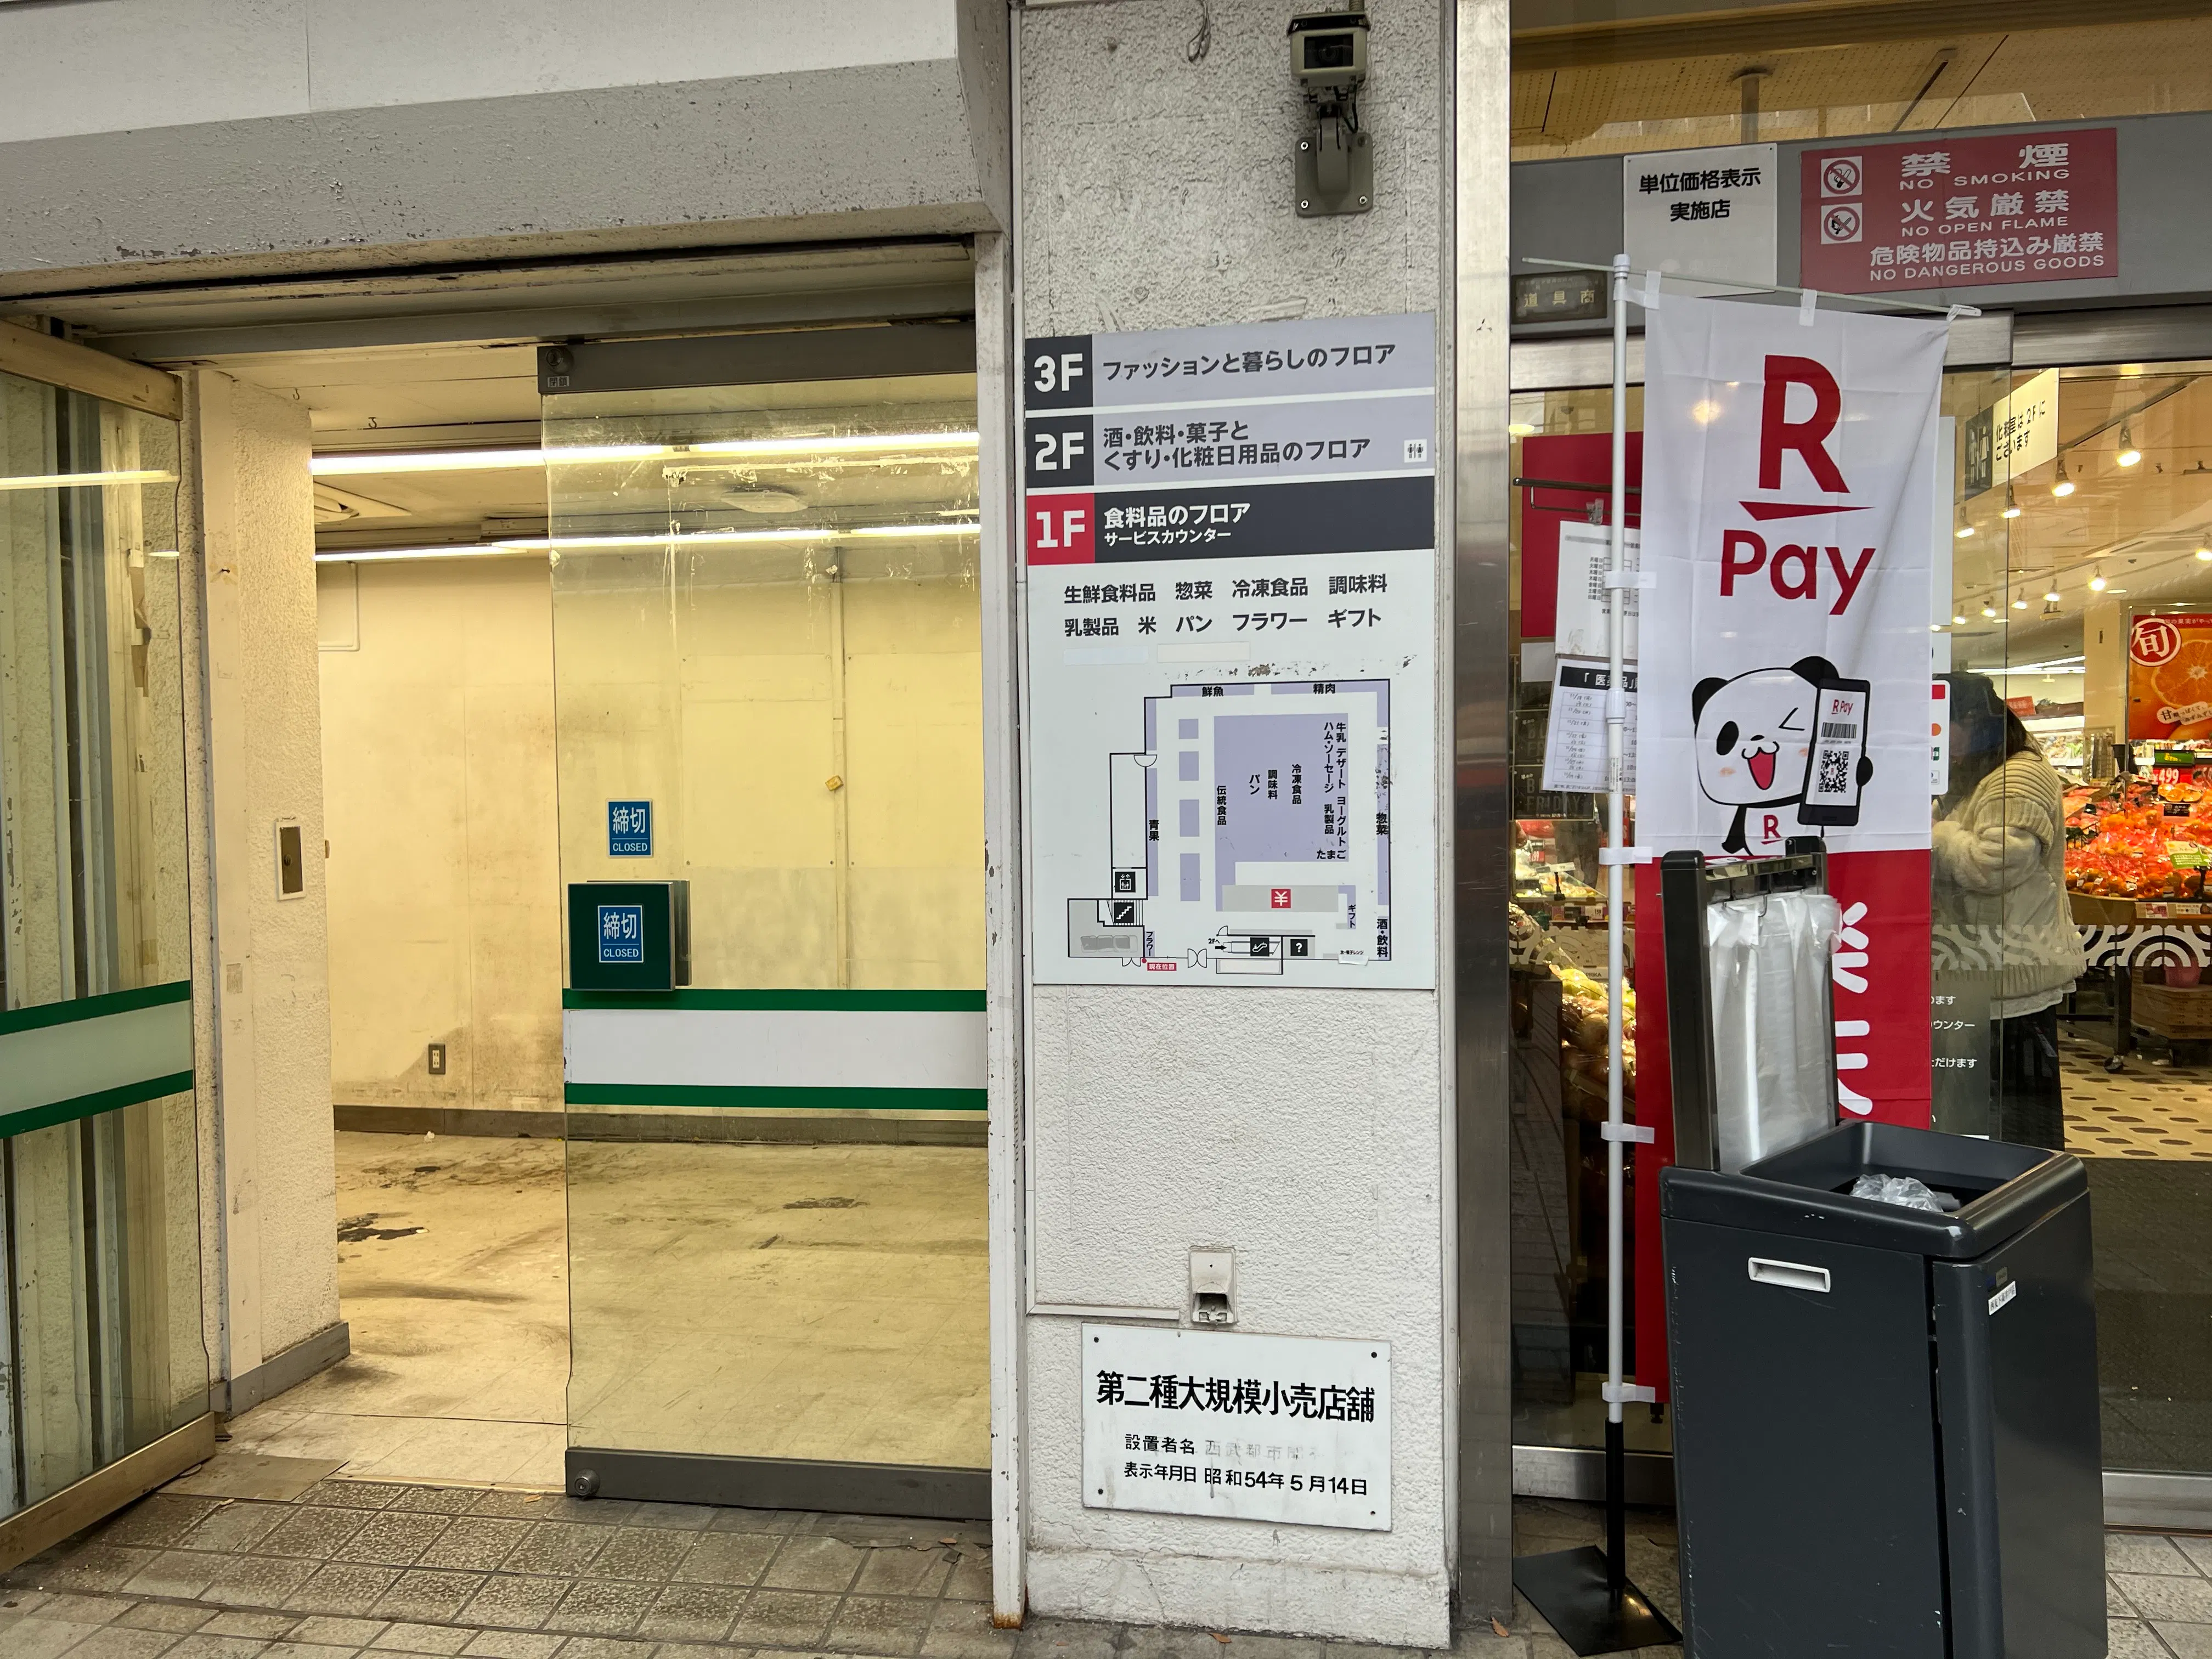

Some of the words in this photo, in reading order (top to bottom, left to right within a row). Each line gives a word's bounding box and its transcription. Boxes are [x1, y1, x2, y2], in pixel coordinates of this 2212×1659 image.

[1639, 167, 1761, 194] 単位価格表示
[1900, 178, 1934, 190] NO
[1954, 169, 2069, 187] SMOKING
[1670, 199, 1730, 222] 実施店
[1901, 189, 2069, 223] 火気厳禁
[1901, 226, 1929, 237] NO
[1938, 222, 1992, 235] OPEN
[2002, 216, 2068, 230] FLAME
[1870, 231, 2104, 267] 危険物品持込み厳禁
[1870, 268, 1897, 281] NO
[1905, 259, 2025, 279] DANGEROUS
[2034, 255, 2104, 269] GOODS
[1033, 353, 1084, 393] 3F
[1103, 343, 1396, 381] ファッションと暮らしのフロア
[1103, 421, 1249, 449] 酒・飲料・菓子と
[1759, 354, 1850, 493] R
[1035, 432, 1084, 471] 2F
[1104, 438, 1372, 471] くすり・化粧日用品のフロア
[1036, 509, 1086, 548] 1F
[1103, 501, 1251, 529] 食料品のフロア
[1104, 527, 1232, 547] サービスカウンター
[1720, 529, 1876, 615] Pay
[1064, 583, 1156, 605] 生鮮食料品
[1175, 580, 1213, 600] 惣菜
[1232, 577, 1308, 599] 冷凍食品
[1328, 573, 1388, 596] 調味料
[1064, 617, 1119, 637] 乳製品
[1138, 616, 1156, 635] 米
[1175, 614, 1213, 634] パン
[1232, 612, 1308, 632] フラワー
[1327, 608, 1381, 628] ギフト
[2132, 625, 2170, 657] 旬
[1201, 685, 1224, 698] 鮮魚
[1313, 682, 1336, 695] 精肉
[1336, 722, 1346, 742] 牛乳
[1324, 722, 1334, 793] ハム・ソーセージ
[1336, 748, 1346, 789] デザート
[1249, 774, 1260, 795] パン
[1268, 770, 1278, 800] 調味料
[1291, 764, 1302, 805] 冷凍食品
[1217, 785, 1227, 826] 伝統食品
[1324, 804, 1334, 834] 乳製品
[612, 806, 646, 834] 締切
[1149, 820, 1159, 841] 青果
[1336, 797, 1347, 847] ヨーグルト
[1376, 812, 1389, 836] 惣菜
[613, 843, 647, 852] CLOSED
[1317, 849, 1346, 860] たまご
[603, 912, 636, 940] 締切
[1377, 919, 1388, 957] 酒・飲料
[603, 948, 639, 958] CLOSED
[1931, 1019, 1975, 1030] ウンター
[1932, 1058, 1977, 1068] だけます
[1096, 1370, 1375, 1423] 第二種大規模小売店舗
[1125, 1434, 1195, 1455] 設置者名
[1124, 1462, 1197, 1483] 表示年月日
